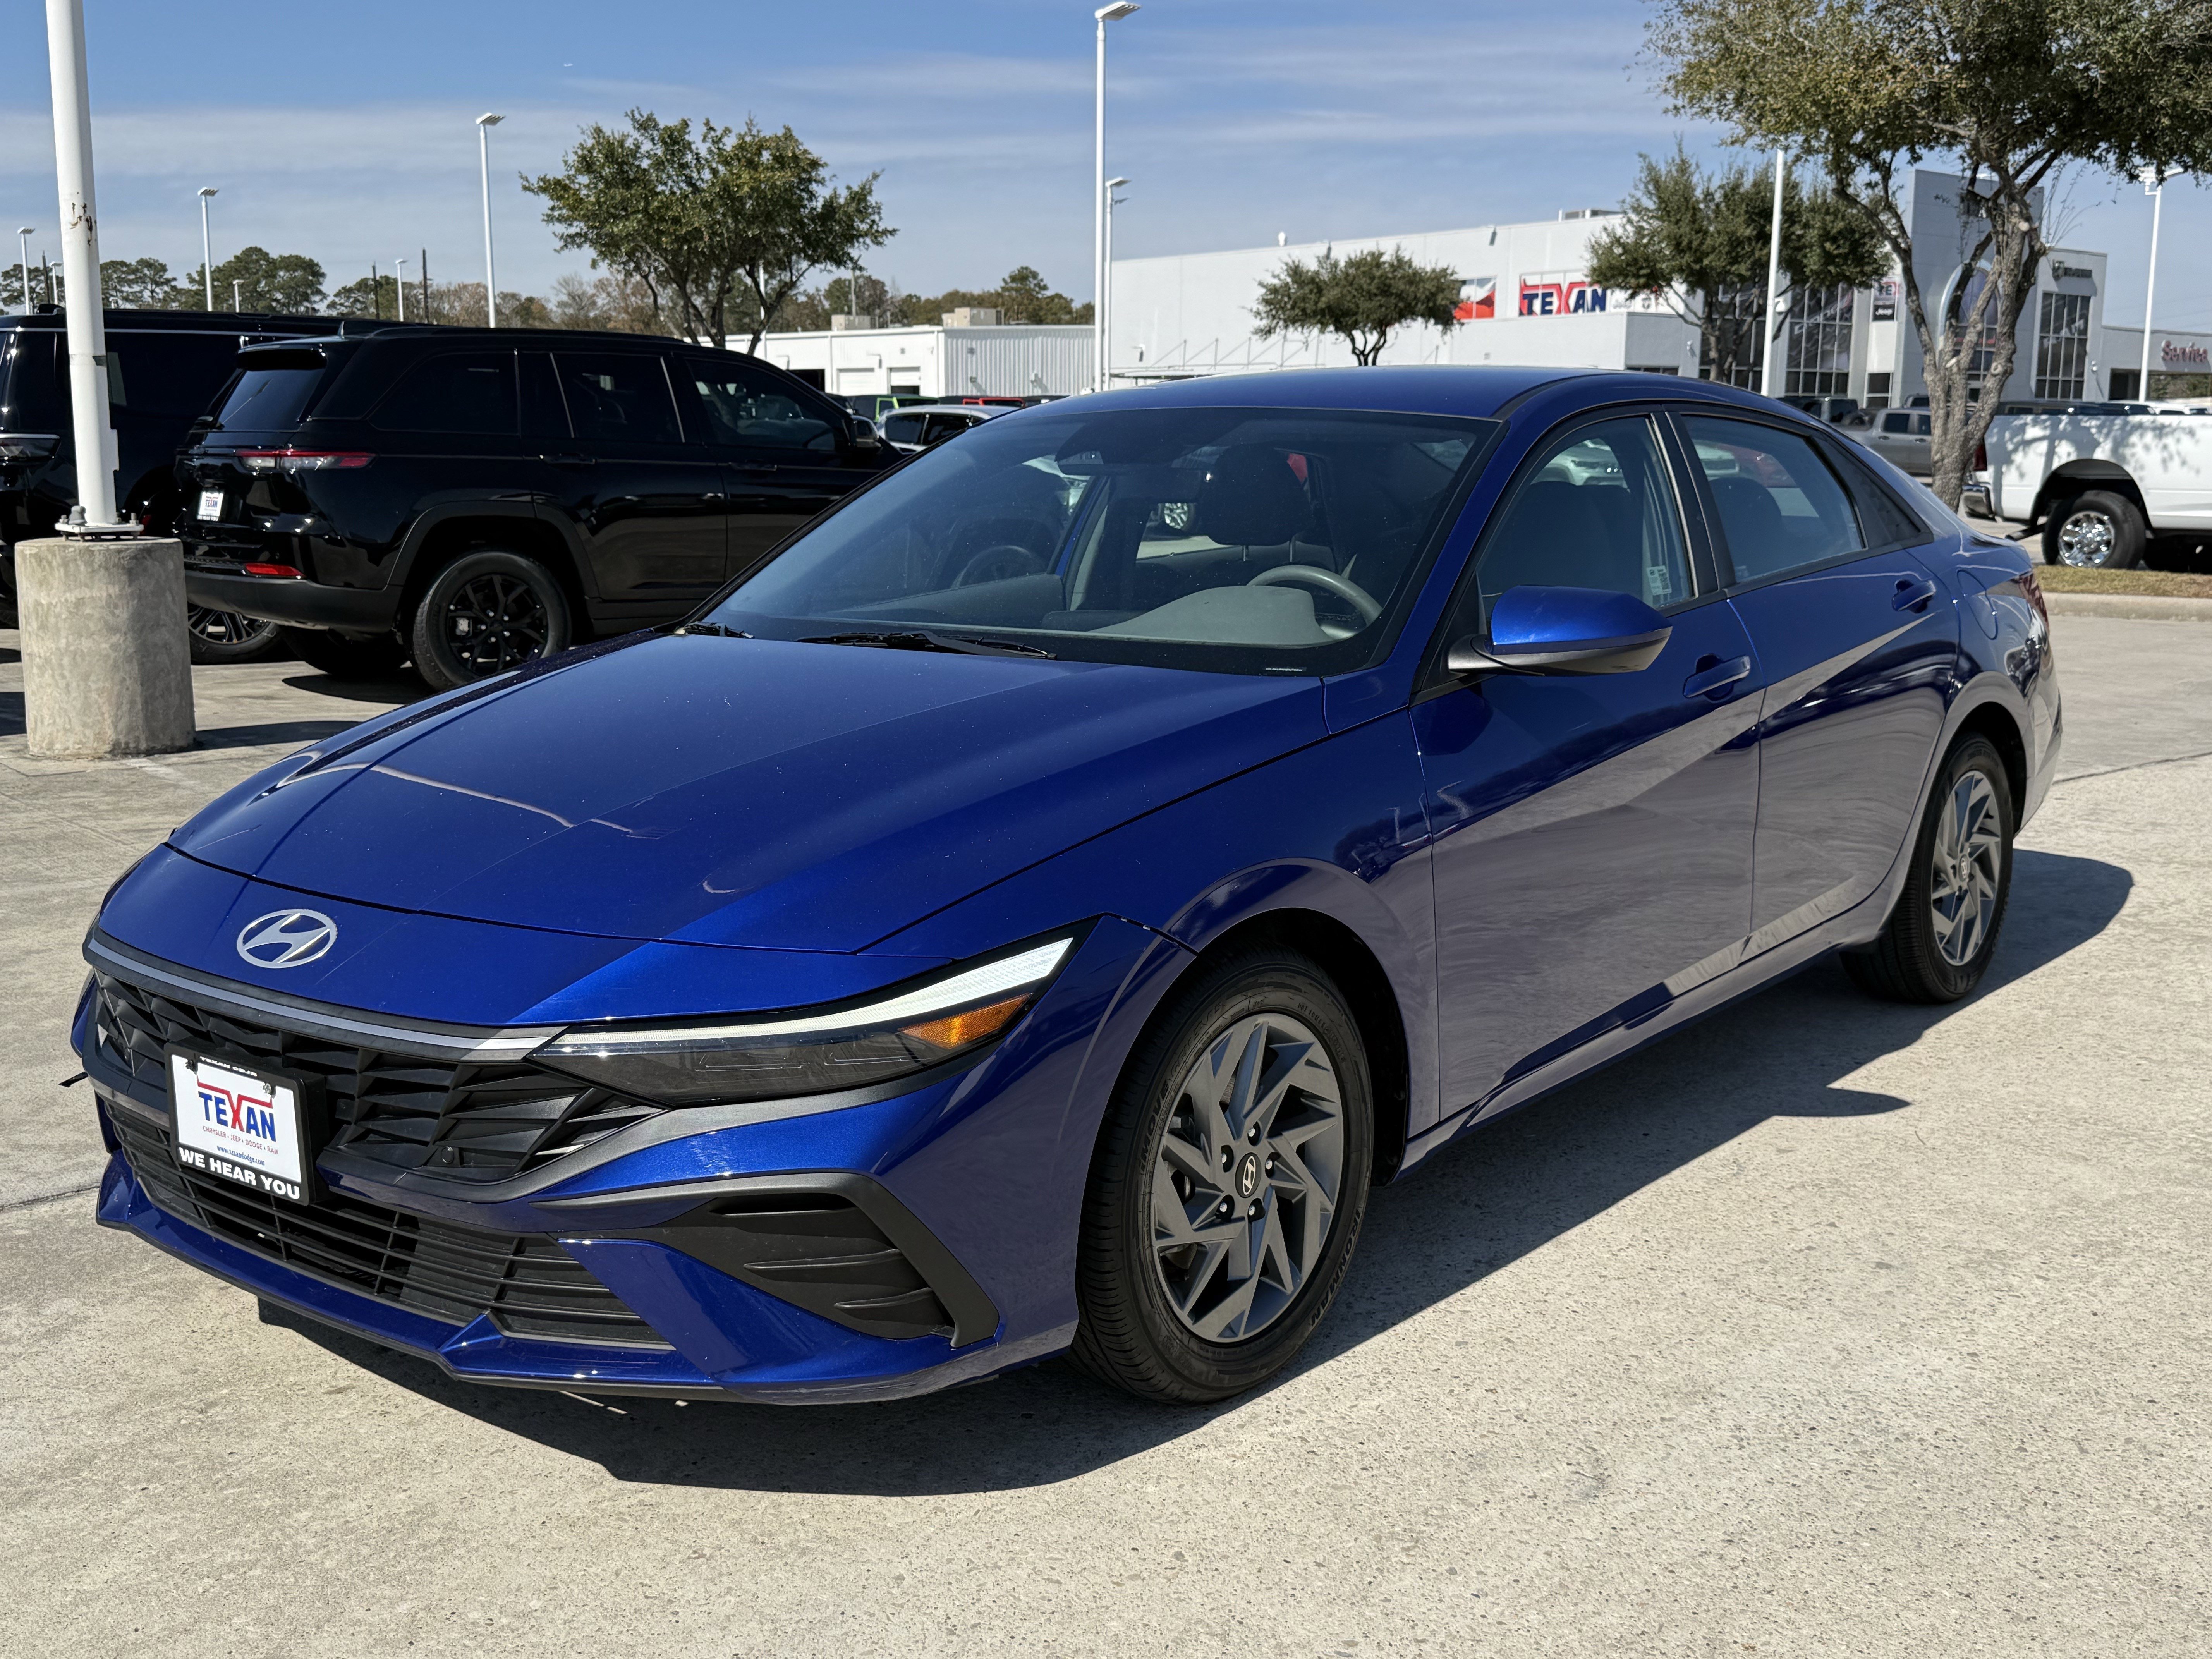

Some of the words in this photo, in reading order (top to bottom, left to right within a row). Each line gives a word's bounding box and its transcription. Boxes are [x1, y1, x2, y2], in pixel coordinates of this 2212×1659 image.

[1522, 282, 1606, 315] TEXAN
[2161, 339, 2207, 362] Service
[200, 1056, 230, 1069] TEXAN
[197, 1082, 276, 1142] TEXAN
[203, 1125, 226, 1138] CHRYSLER
[231, 1134, 241, 1143] JEEP
[245, 1139, 263, 1150] DODGE
[267, 1146, 279, 1155] RAM
[217, 1145, 265, 1166] www.texandodge.com
[179, 1147, 205, 1168] WE
[210, 1157, 256, 1186] HEAR
[260, 1175, 300, 1199] YOU
[1311, 1208, 1361, 1327] IRONMAN
